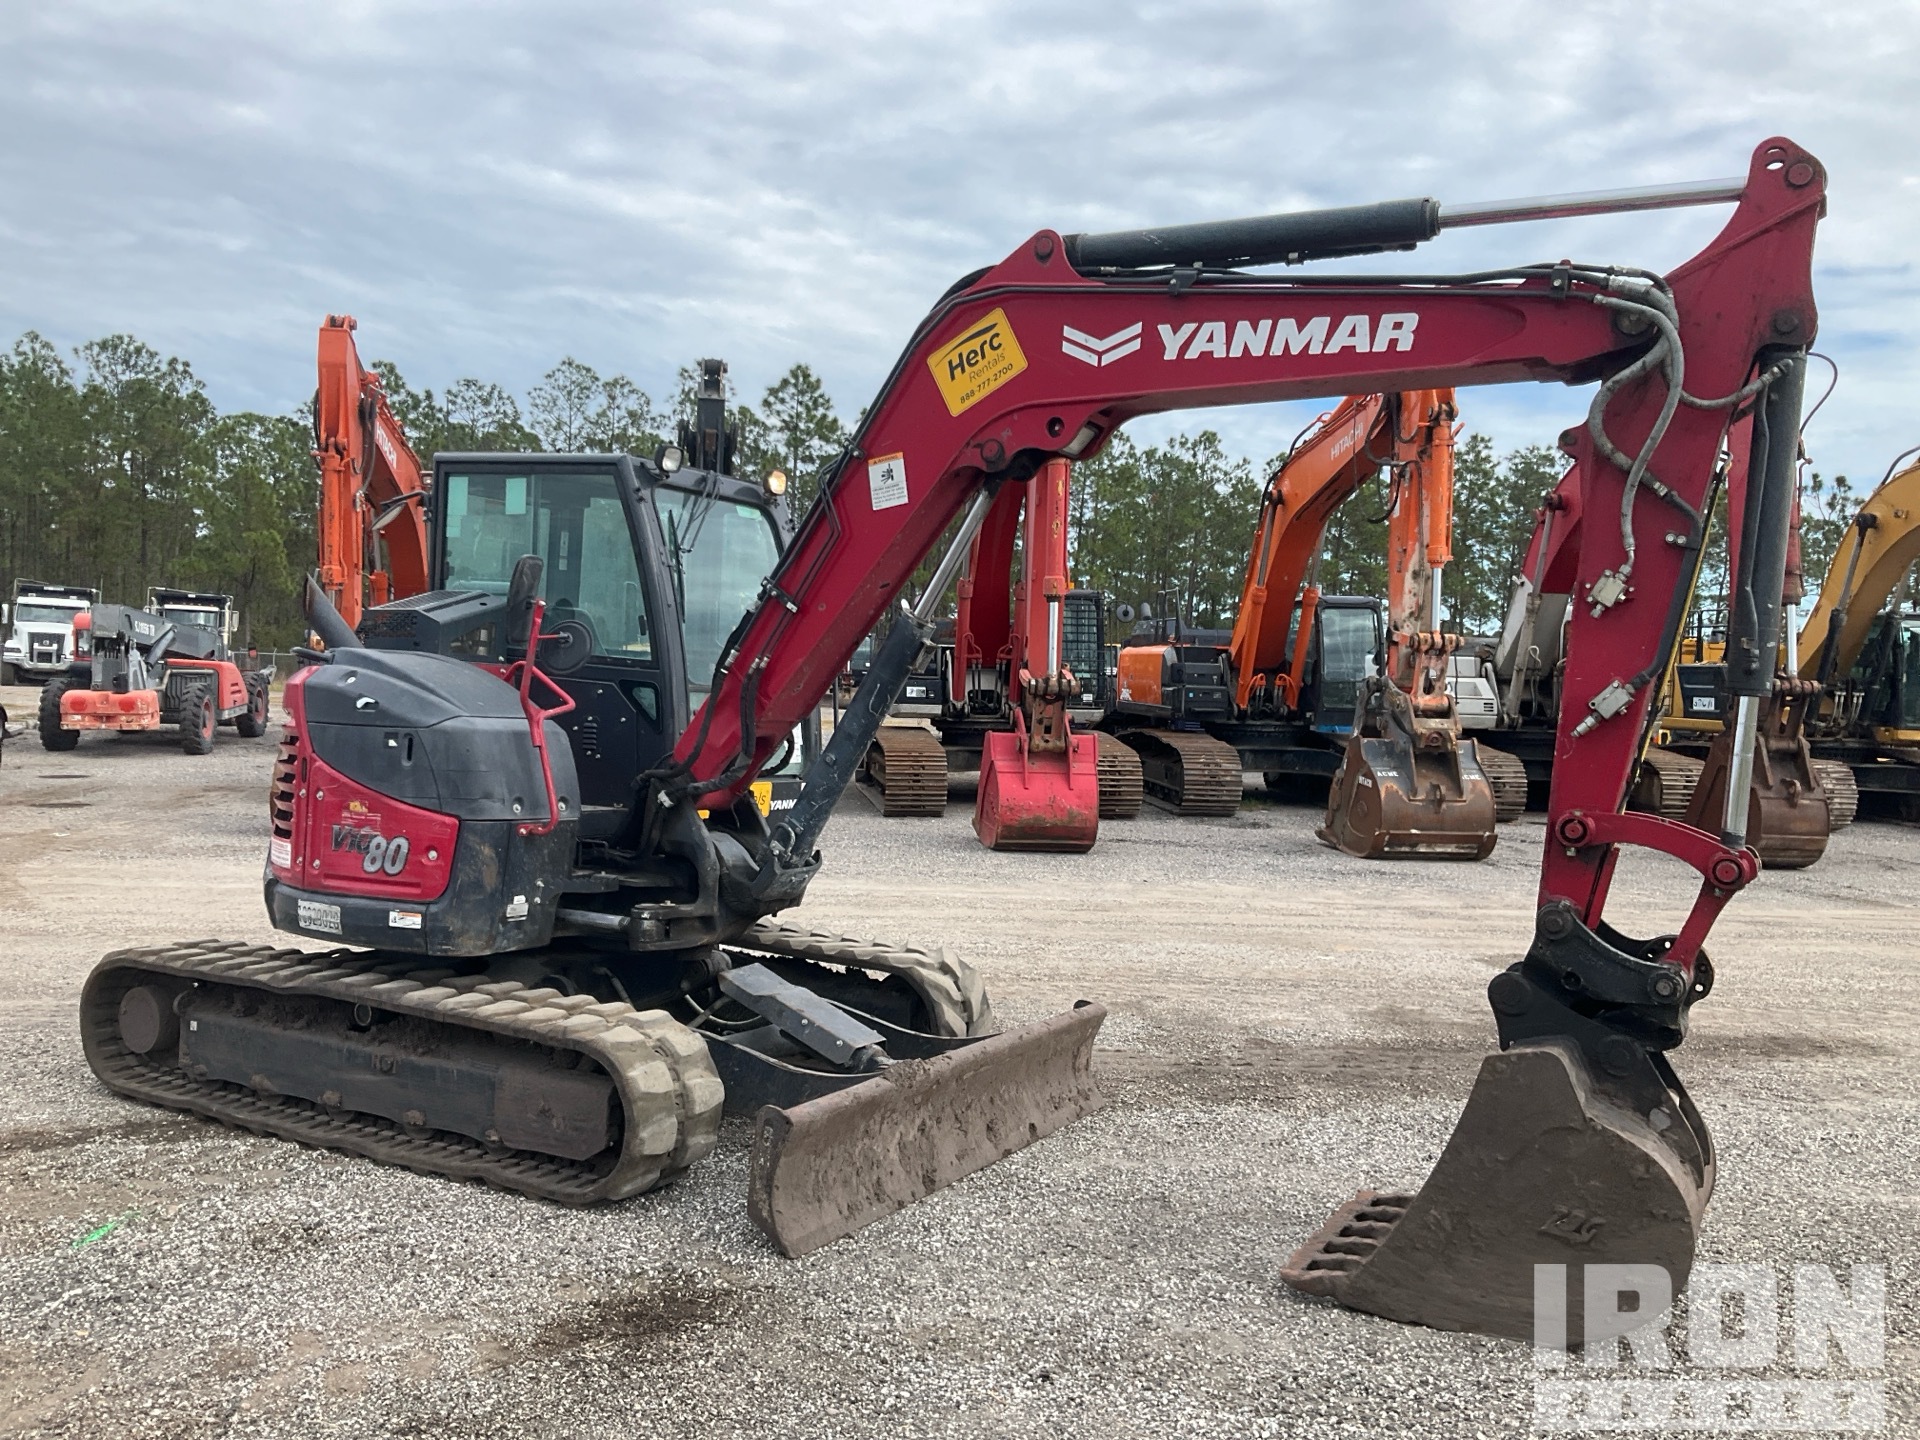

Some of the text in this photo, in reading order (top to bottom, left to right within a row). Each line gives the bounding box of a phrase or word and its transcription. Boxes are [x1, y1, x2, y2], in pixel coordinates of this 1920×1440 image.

[947, 332, 1003, 382] Herc
[1157, 312, 1419, 361] YANMAR
[960, 363, 1014, 405] 888-777-2700
[968, 352, 1006, 383] Rentals
[1377, 770, 1400, 778] ACME
